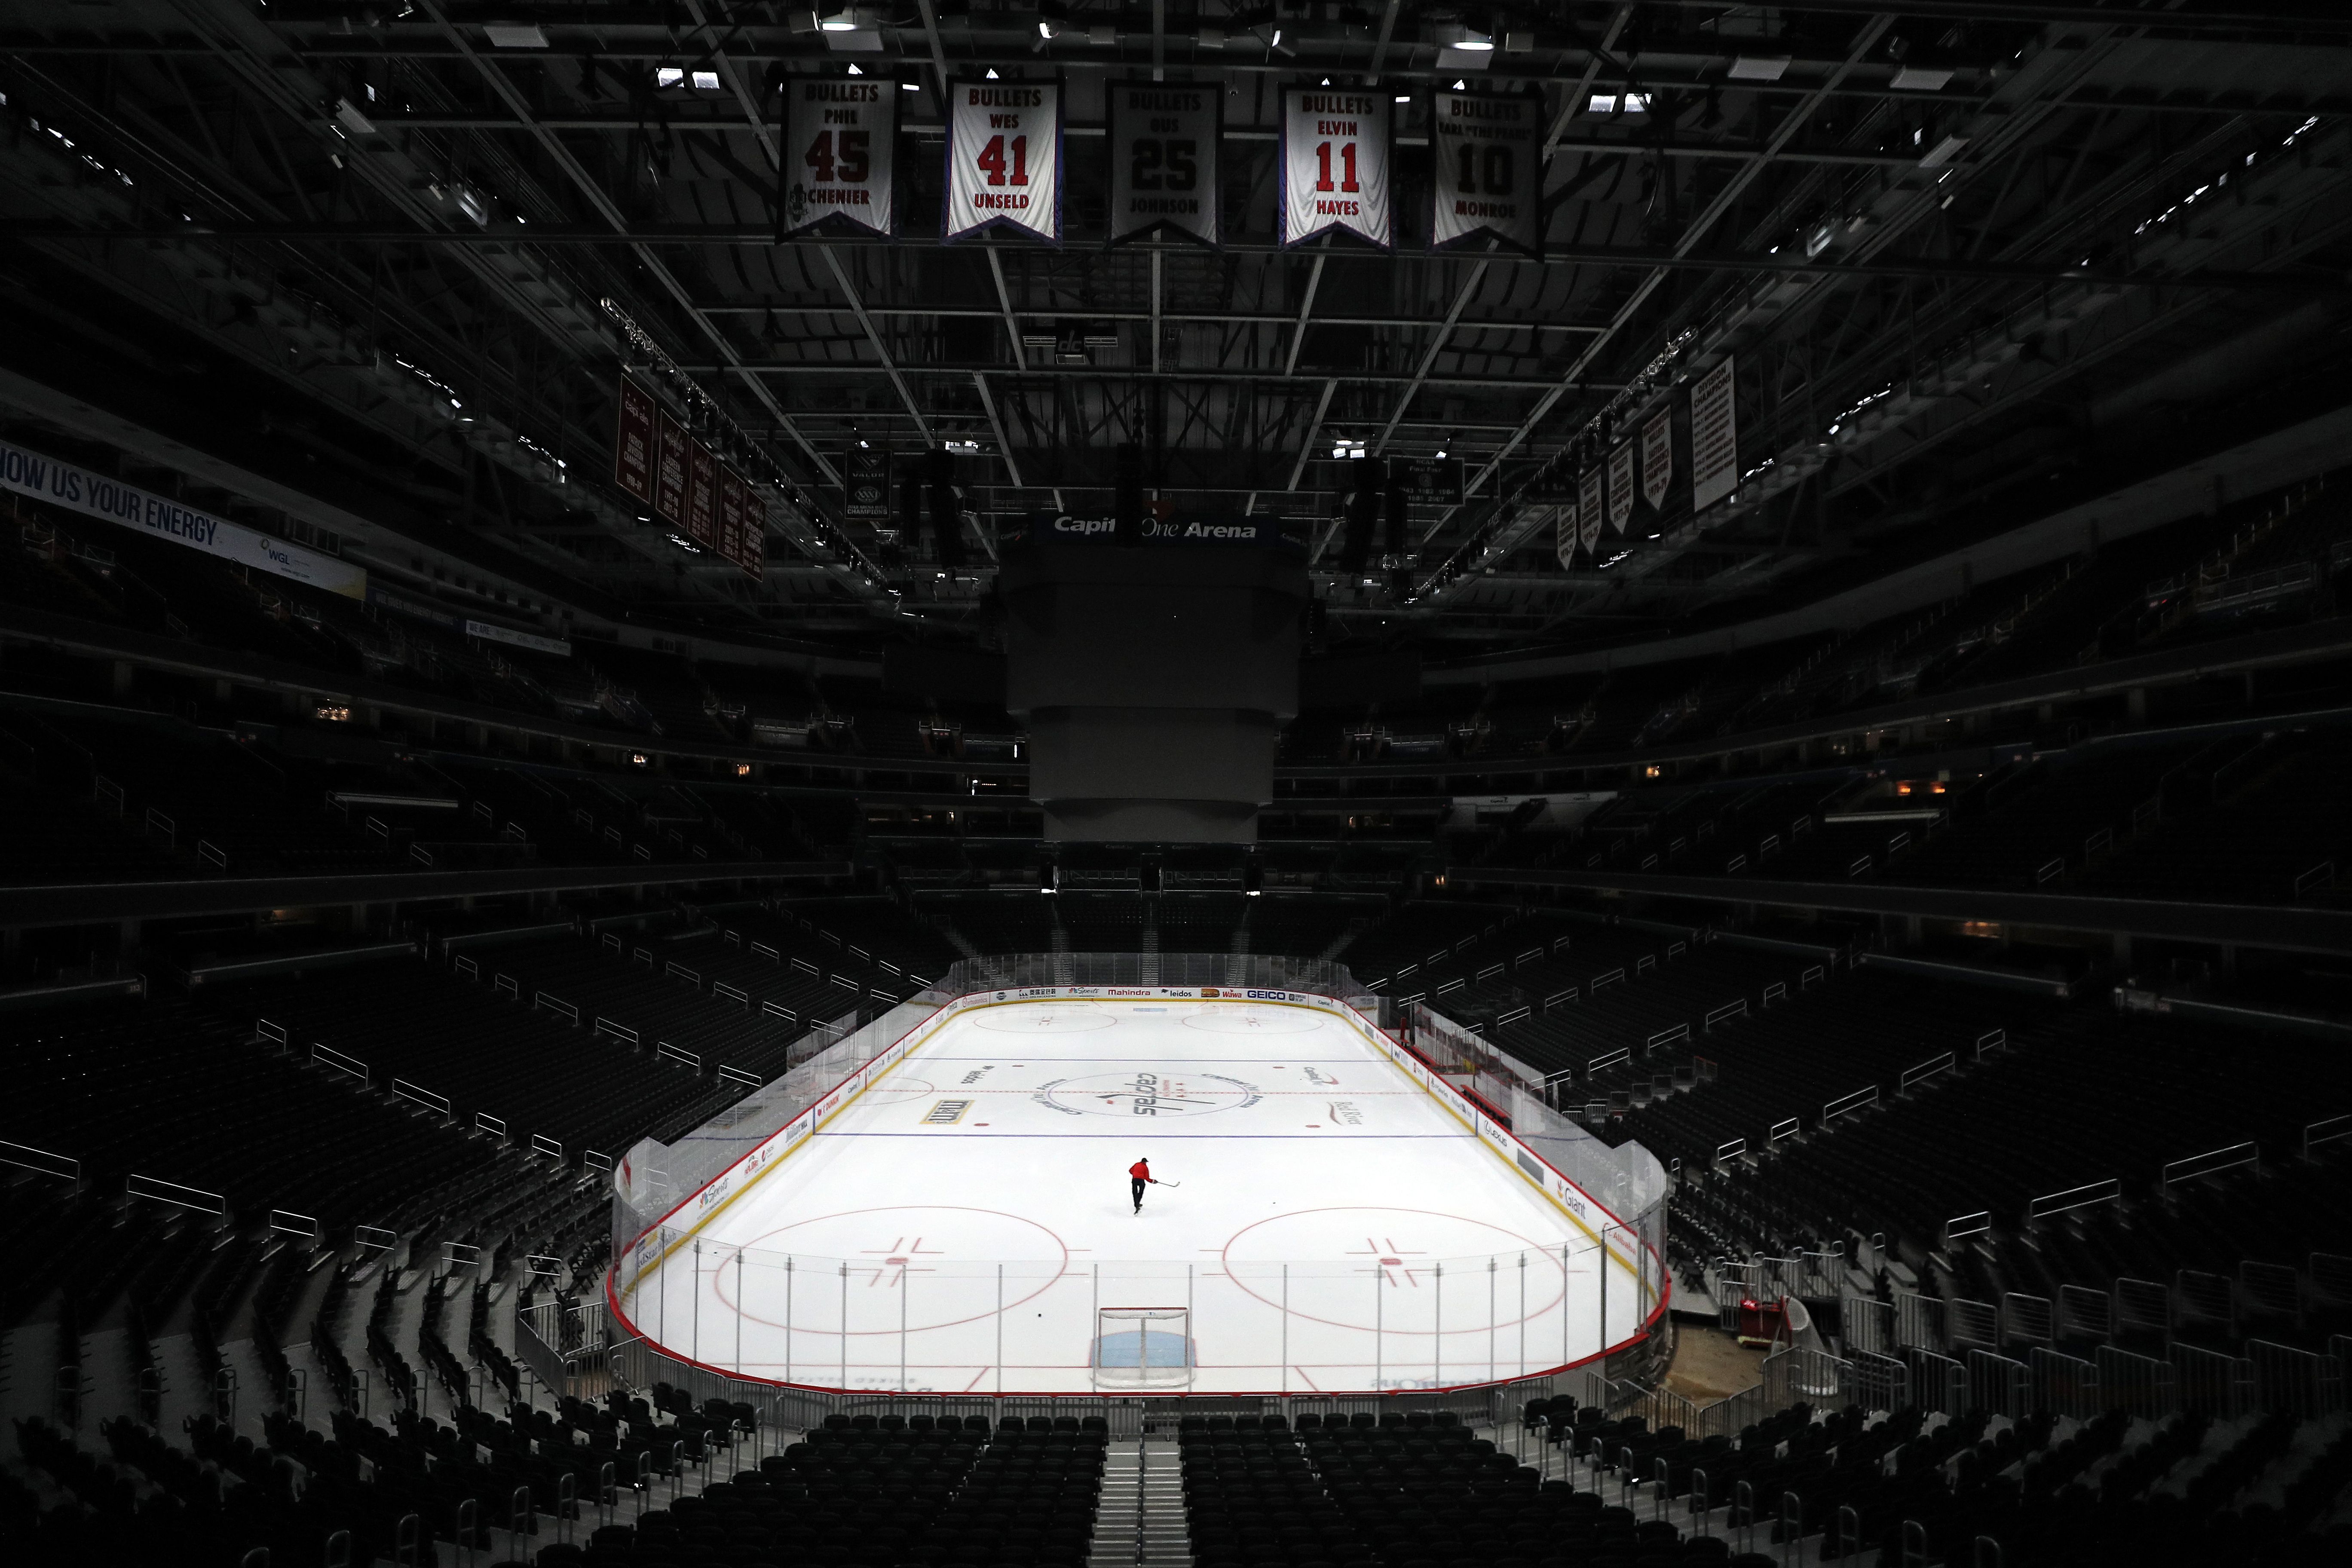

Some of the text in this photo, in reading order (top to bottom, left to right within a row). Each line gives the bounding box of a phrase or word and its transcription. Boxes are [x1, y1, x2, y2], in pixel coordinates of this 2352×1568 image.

[805, 84, 878, 102] BULLETS
[969, 88, 1041, 107] BULLETS
[1129, 92, 1201, 110] BULLETS
[1302, 95, 1373, 114] BULLETS
[1452, 99, 1521, 121] BULLETS
[824, 110, 857, 123] PHIL
[989, 114, 1019, 128] WES
[1318, 120, 1357, 135] ELVIN
[805, 131, 869, 182] 45
[977, 135, 1028, 185] 41
[1132, 139, 1196, 190] 25
[1316, 141, 1359, 193] 11
[1458, 144, 1513, 195] 10
[808, 189, 869, 204] CHENIER
[975, 194, 1029, 208] UNSELD
[1130, 198, 1198, 214] JOHNSON
[1317, 200, 1359, 215] HAYES
[1455, 200, 1516, 217] MONROE
[1694, 371, 1732, 407] CHAMPIONS
[1698, 364, 1727, 395] DIVISION
[51, 466, 81, 502] US
[86, 476, 141, 522] YOUR
[145, 498, 217, 545] ENERGY
[1054, 516, 1115, 536] Capit
[1183, 521, 1256, 538] Arena
[269, 549, 290, 565] WGL
[1247, 990, 1286, 1000] GEICO
[1334, 1102, 1363, 1125] Red River
[1490, 1127, 1507, 1147] LEXUS
[708, 1177, 729, 1203] Sports
[1565, 1188, 1586, 1219] Giant
[1613, 1231, 1637, 1256] Alibaba
